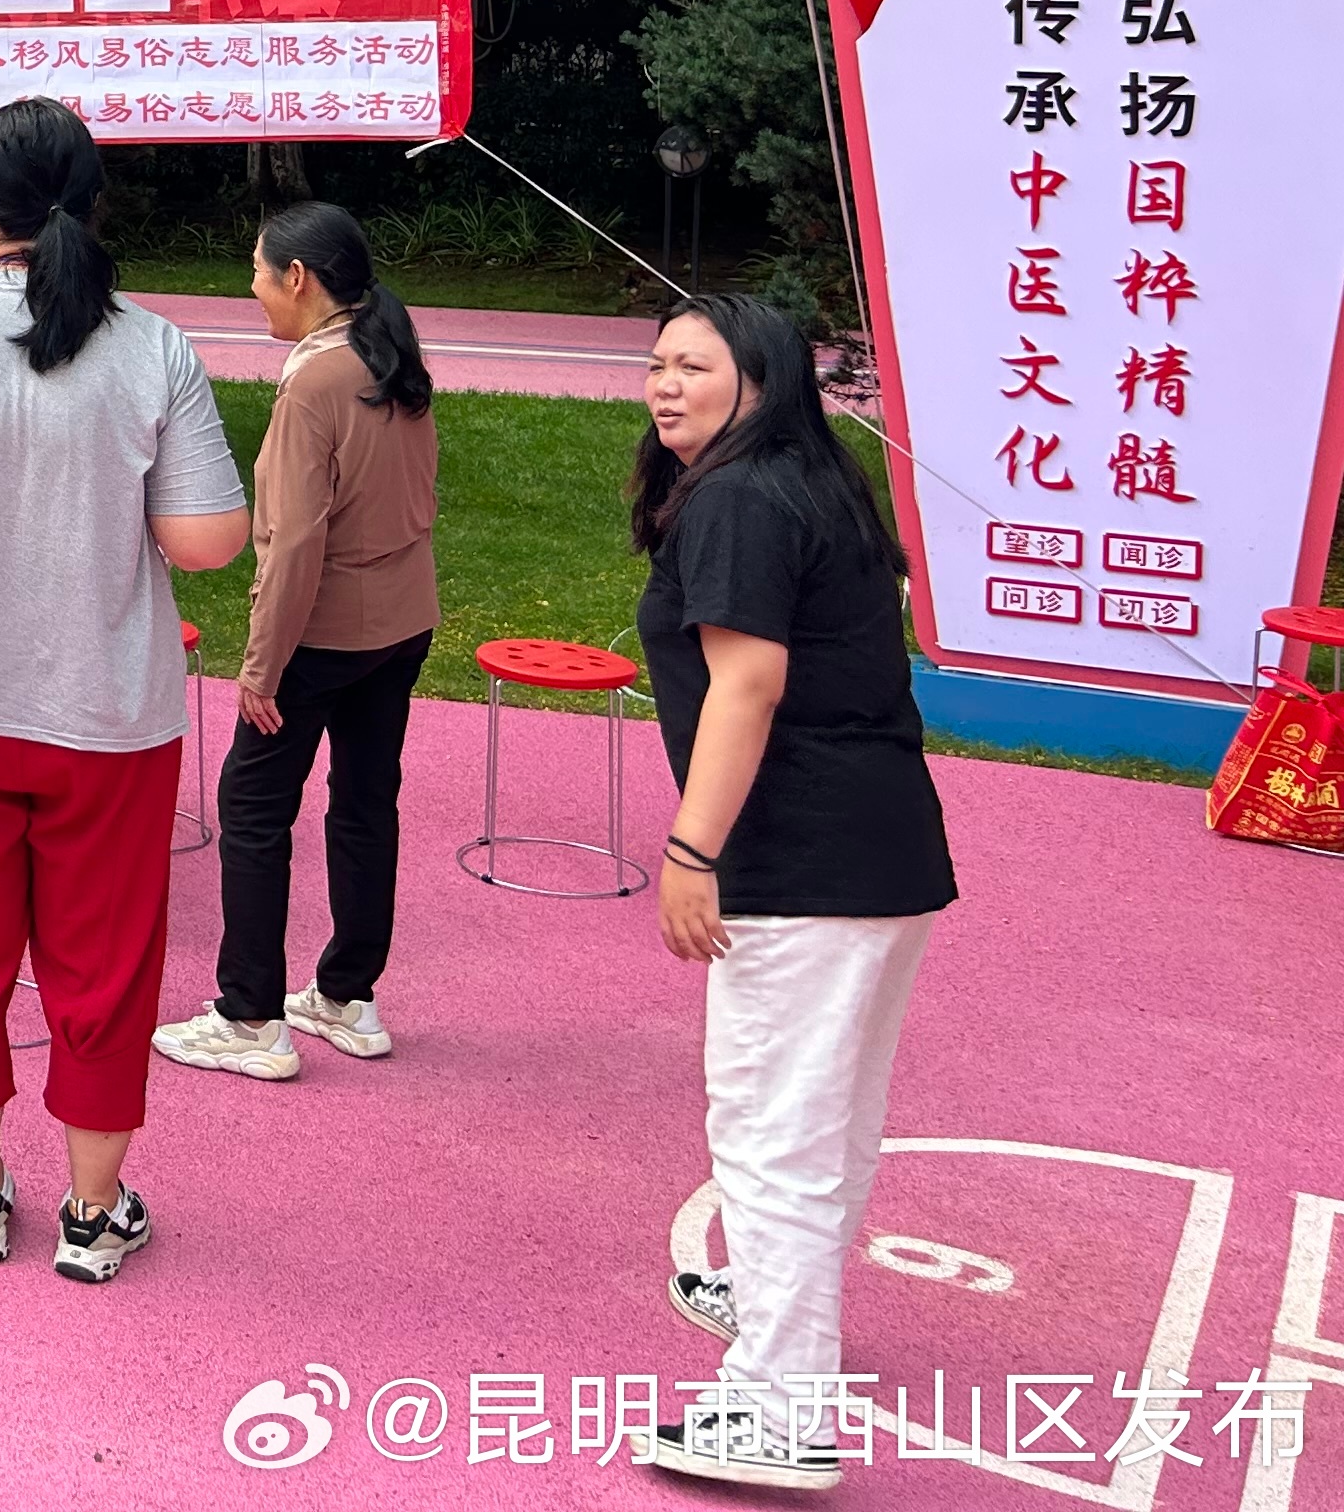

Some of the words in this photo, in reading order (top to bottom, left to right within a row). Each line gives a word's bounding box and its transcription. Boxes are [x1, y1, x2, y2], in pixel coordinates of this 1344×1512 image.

[1003, 530, 1065, 556] 望诊
[1120, 541, 1184, 569] 闻诊
[1002, 585, 1064, 613] 问诊
[1118, 599, 1180, 625] 切诊
